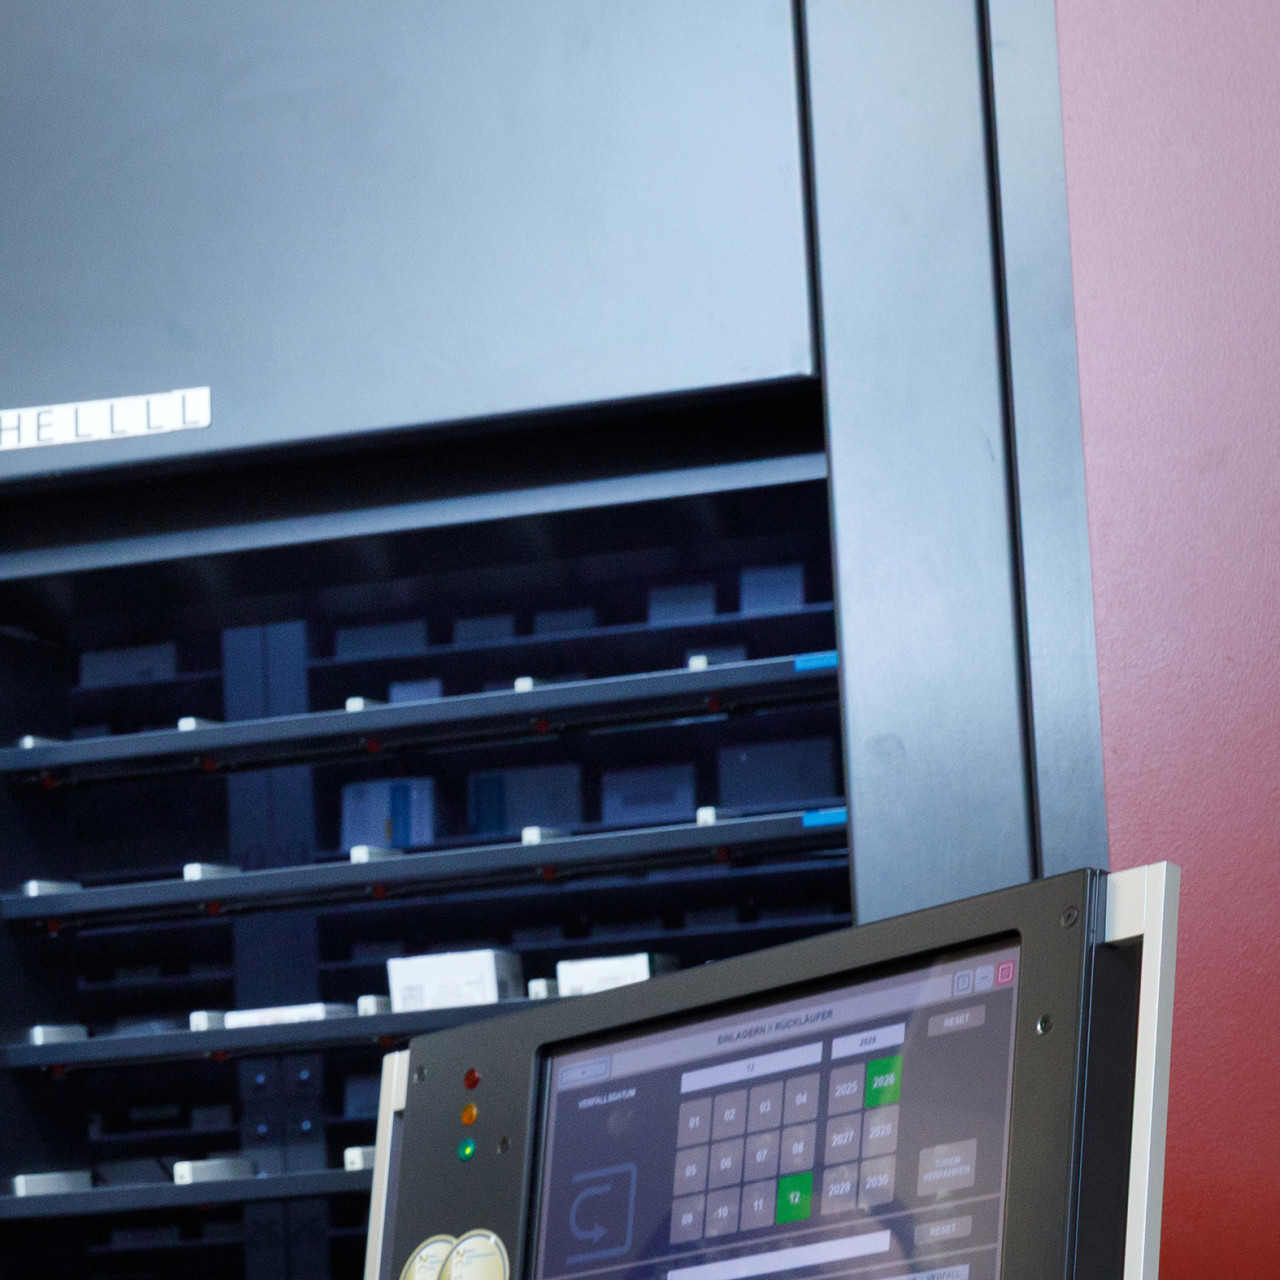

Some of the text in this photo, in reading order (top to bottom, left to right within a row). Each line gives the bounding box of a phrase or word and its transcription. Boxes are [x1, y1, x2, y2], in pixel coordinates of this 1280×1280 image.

[872, 1072, 896, 1089] 2026
[835, 1080, 859, 1097] 2025
[795, 1092, 808, 1106] 04
[759, 1100, 772, 1113] 03
[724, 1109, 736, 1121] 02
[689, 1116, 700, 1128] 01
[831, 1131, 855, 1147] 2027
[792, 1141, 804, 1155] 08
[756, 1149, 768, 1162] 07
[685, 1164, 697, 1176] 05
[828, 1180, 852, 1197] 2029
[865, 1174, 889, 1191] 2030
[790, 1191, 801, 1204] 12
[752, 1198, 764, 1211] 11
[717, 1206, 729, 1218] 10
